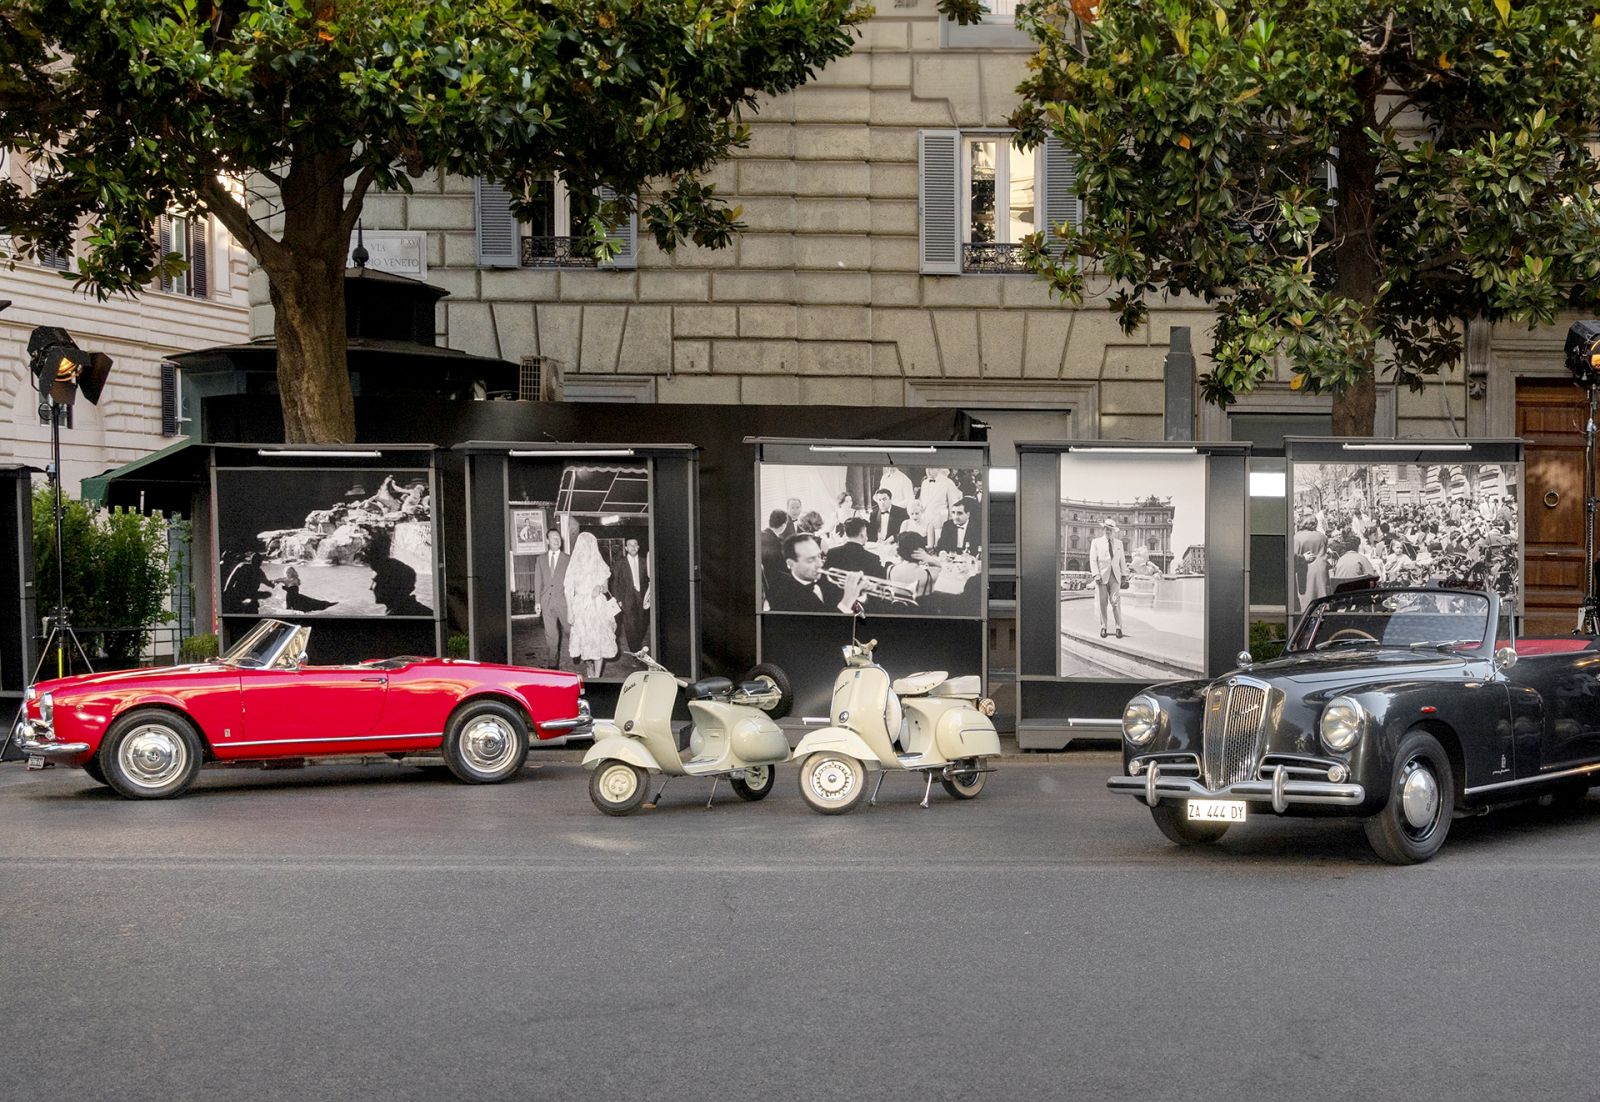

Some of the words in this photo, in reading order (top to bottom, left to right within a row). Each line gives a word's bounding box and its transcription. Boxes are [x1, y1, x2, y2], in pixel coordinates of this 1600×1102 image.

[370, 243, 386, 252] VIA
[384, 258, 419, 267] VENETO
[1189, 805, 1201, 818] ZA
[1207, 805, 1225, 818] 444
[1231, 806, 1244, 819] DY
